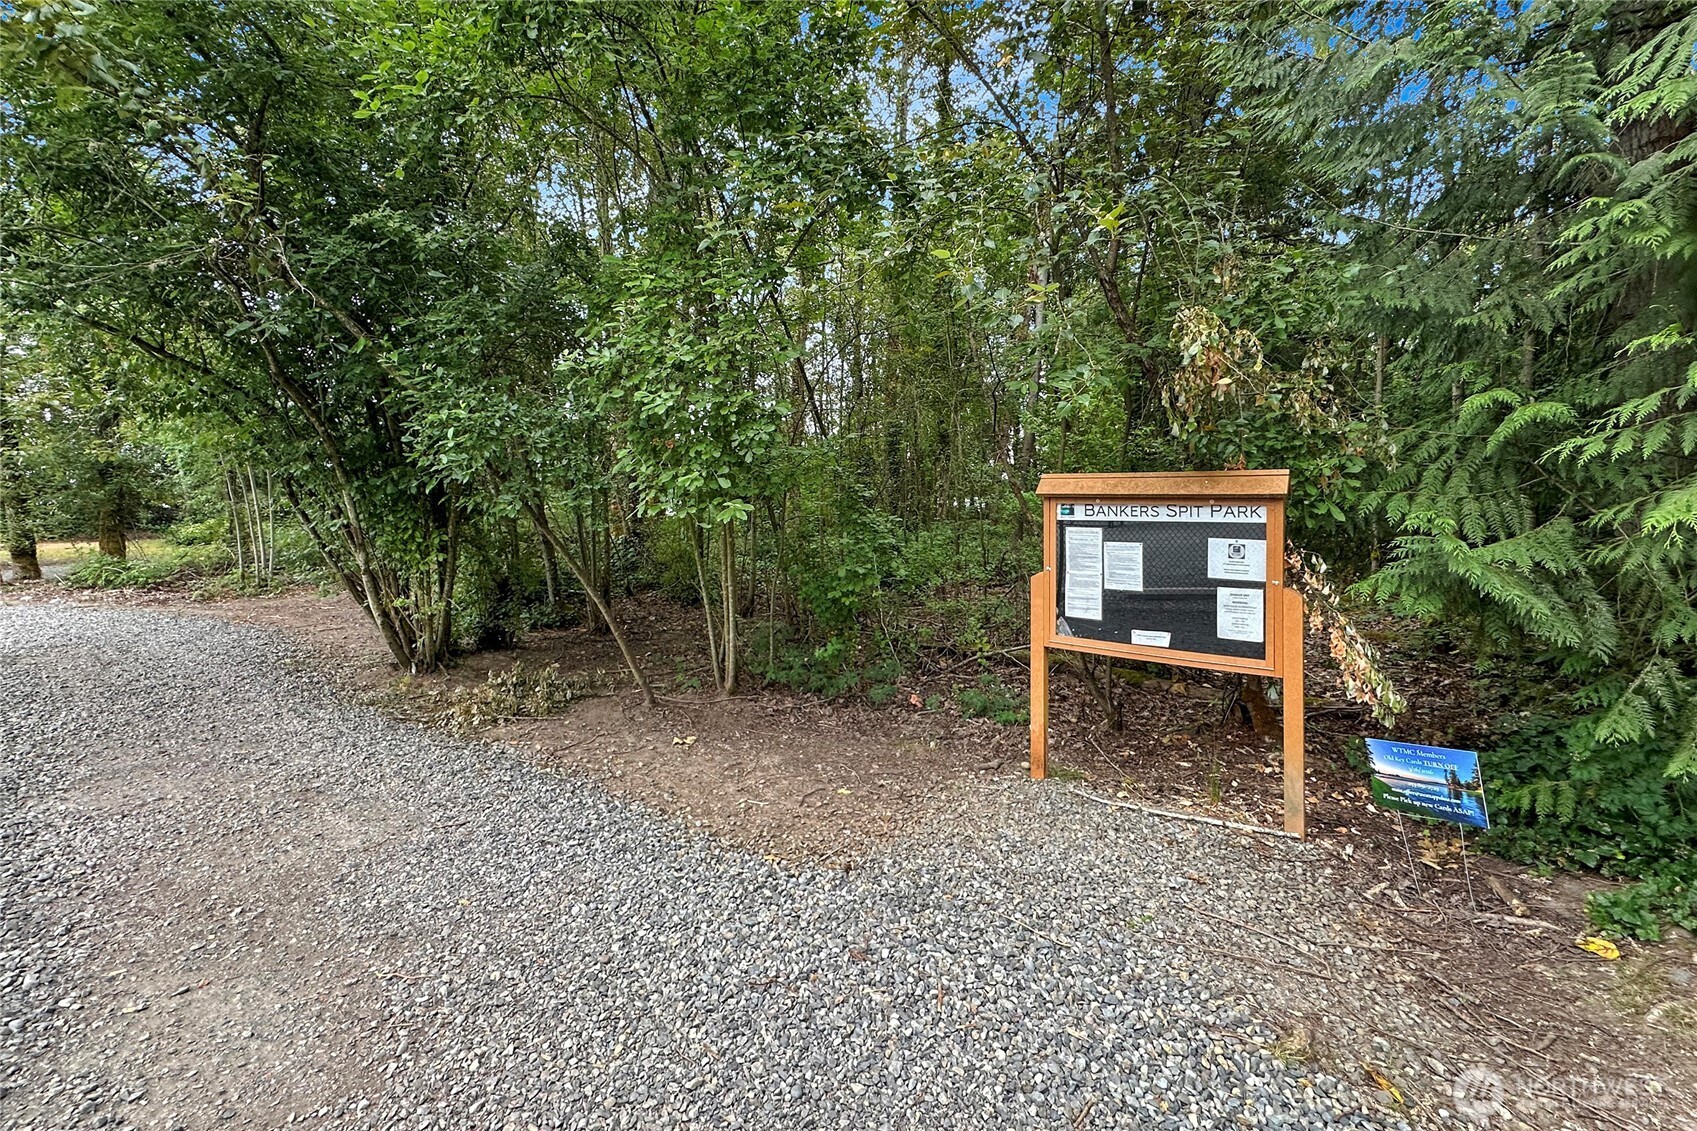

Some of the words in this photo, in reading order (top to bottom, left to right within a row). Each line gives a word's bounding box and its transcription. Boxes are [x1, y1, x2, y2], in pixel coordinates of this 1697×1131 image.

[1084, 504, 1160, 518] BANKERS
[1166, 504, 1203, 518] SPIT
[1210, 504, 1262, 519] PARK
[1391, 747, 1415, 756] WTMC
[1416, 749, 1446, 760] Members
[1394, 756, 1405, 764] Key
[1405, 757, 1422, 765] Cards
[1423, 760, 1443, 769] TURN
[1443, 763, 1458, 771] OFF
[1383, 793, 1399, 802] Please
[1400, 796, 1412, 804] Pick
[1434, 803, 1452, 812] Cards
